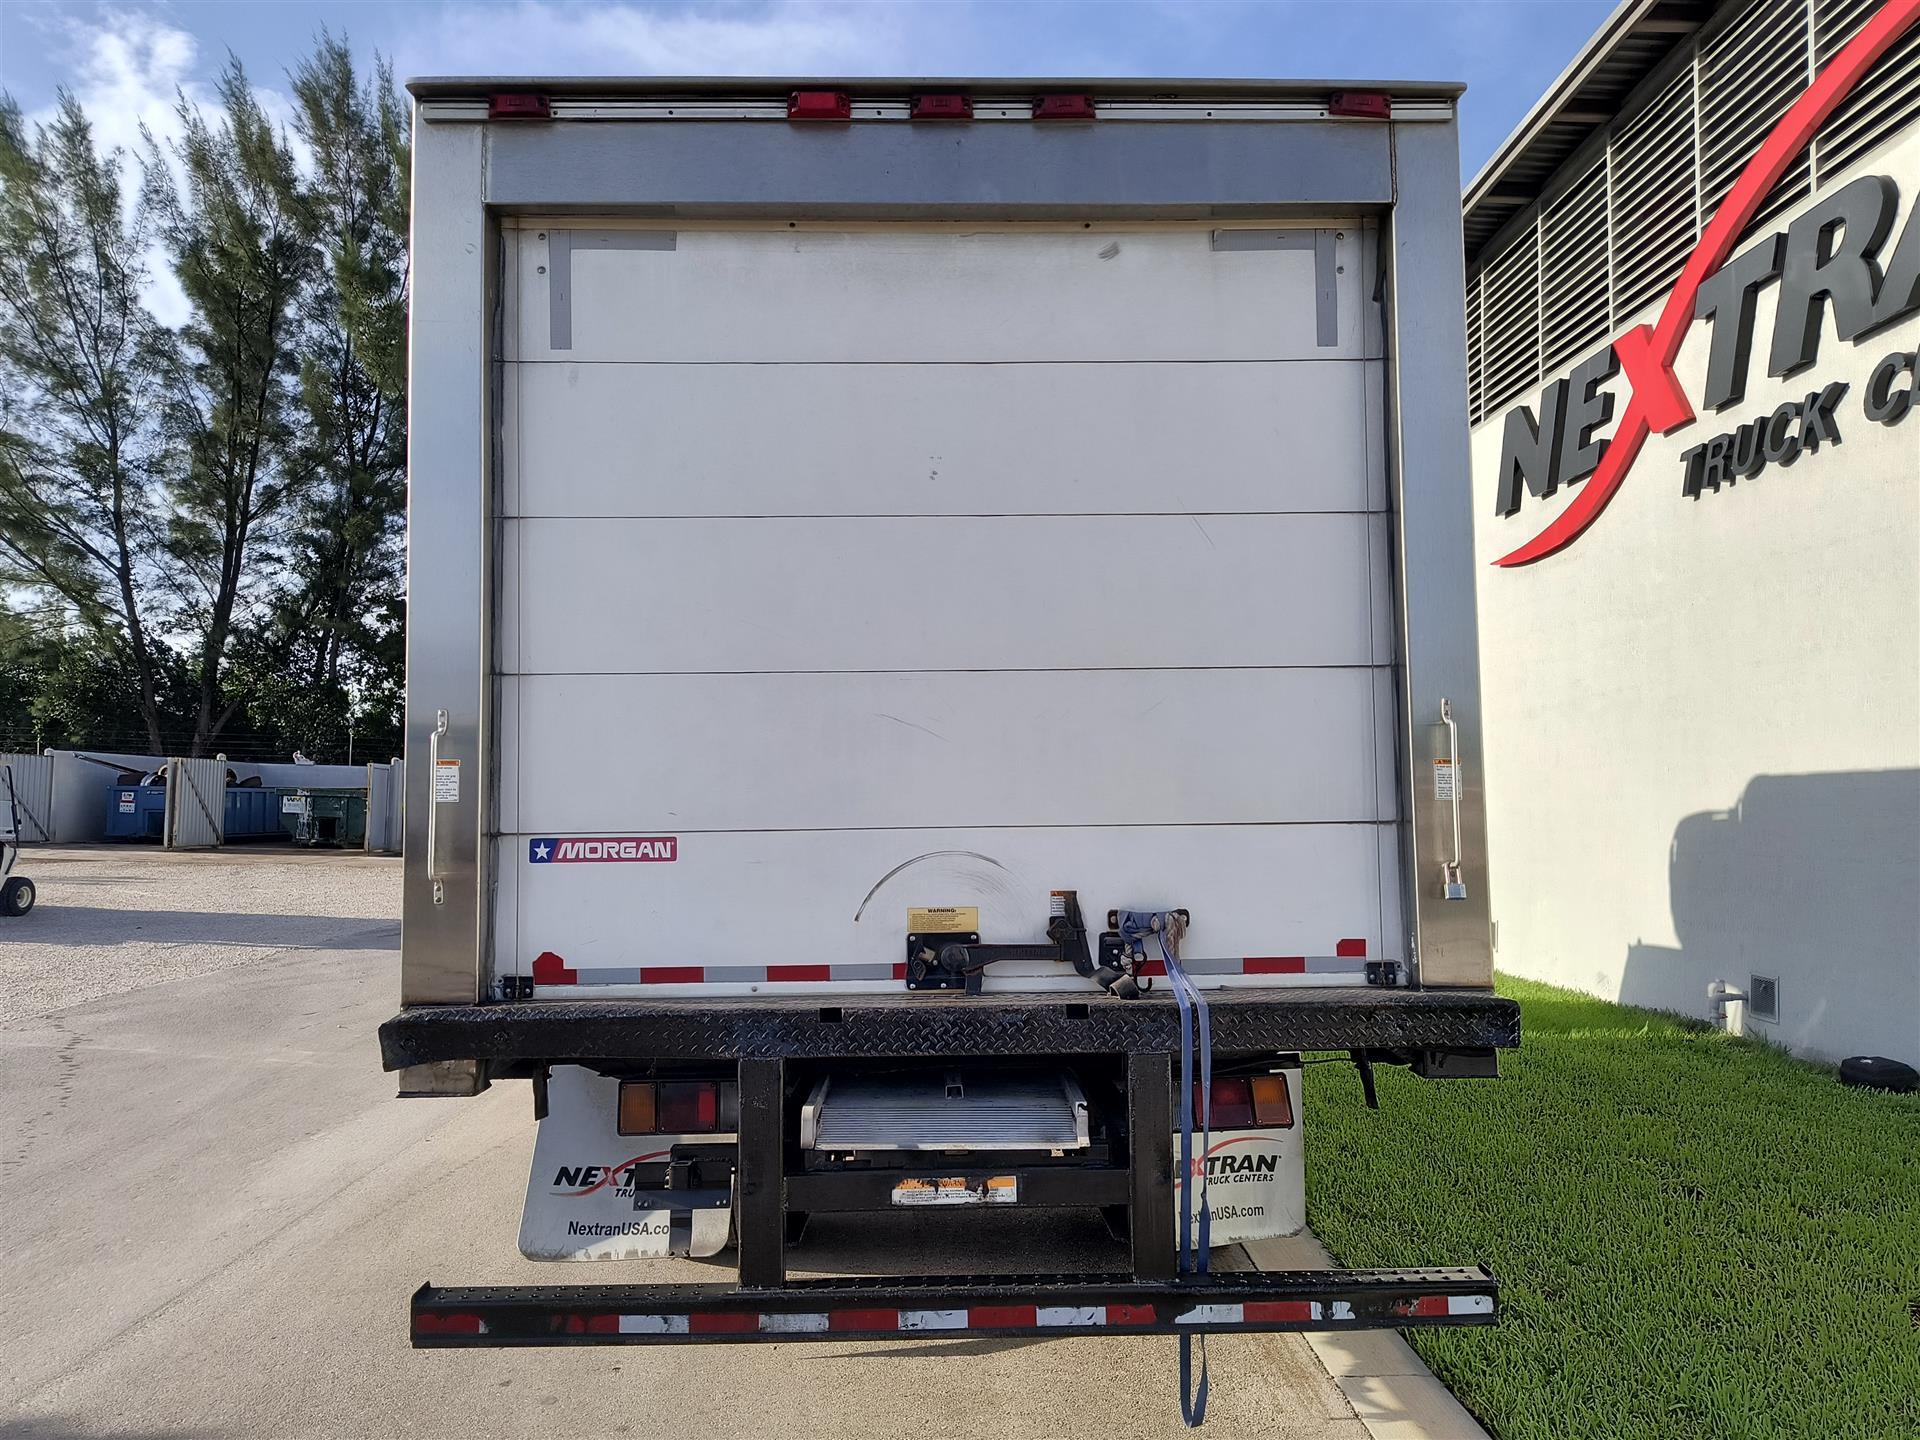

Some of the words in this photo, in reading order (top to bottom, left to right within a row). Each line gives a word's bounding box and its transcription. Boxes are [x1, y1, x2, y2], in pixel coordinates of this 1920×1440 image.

[1680, 382, 1850, 501] TRUCK
[1863, 343, 1920, 426] C
[557, 841, 672, 859] MORGAN
[553, 1166, 635, 1187] NEXT
[1205, 1175, 1230, 1186] RUCK
[1233, 1174, 1274, 1183] CENTERS
[615, 1188, 635, 1197] TRU
[568, 1221, 669, 1236] NextranUSA.co
